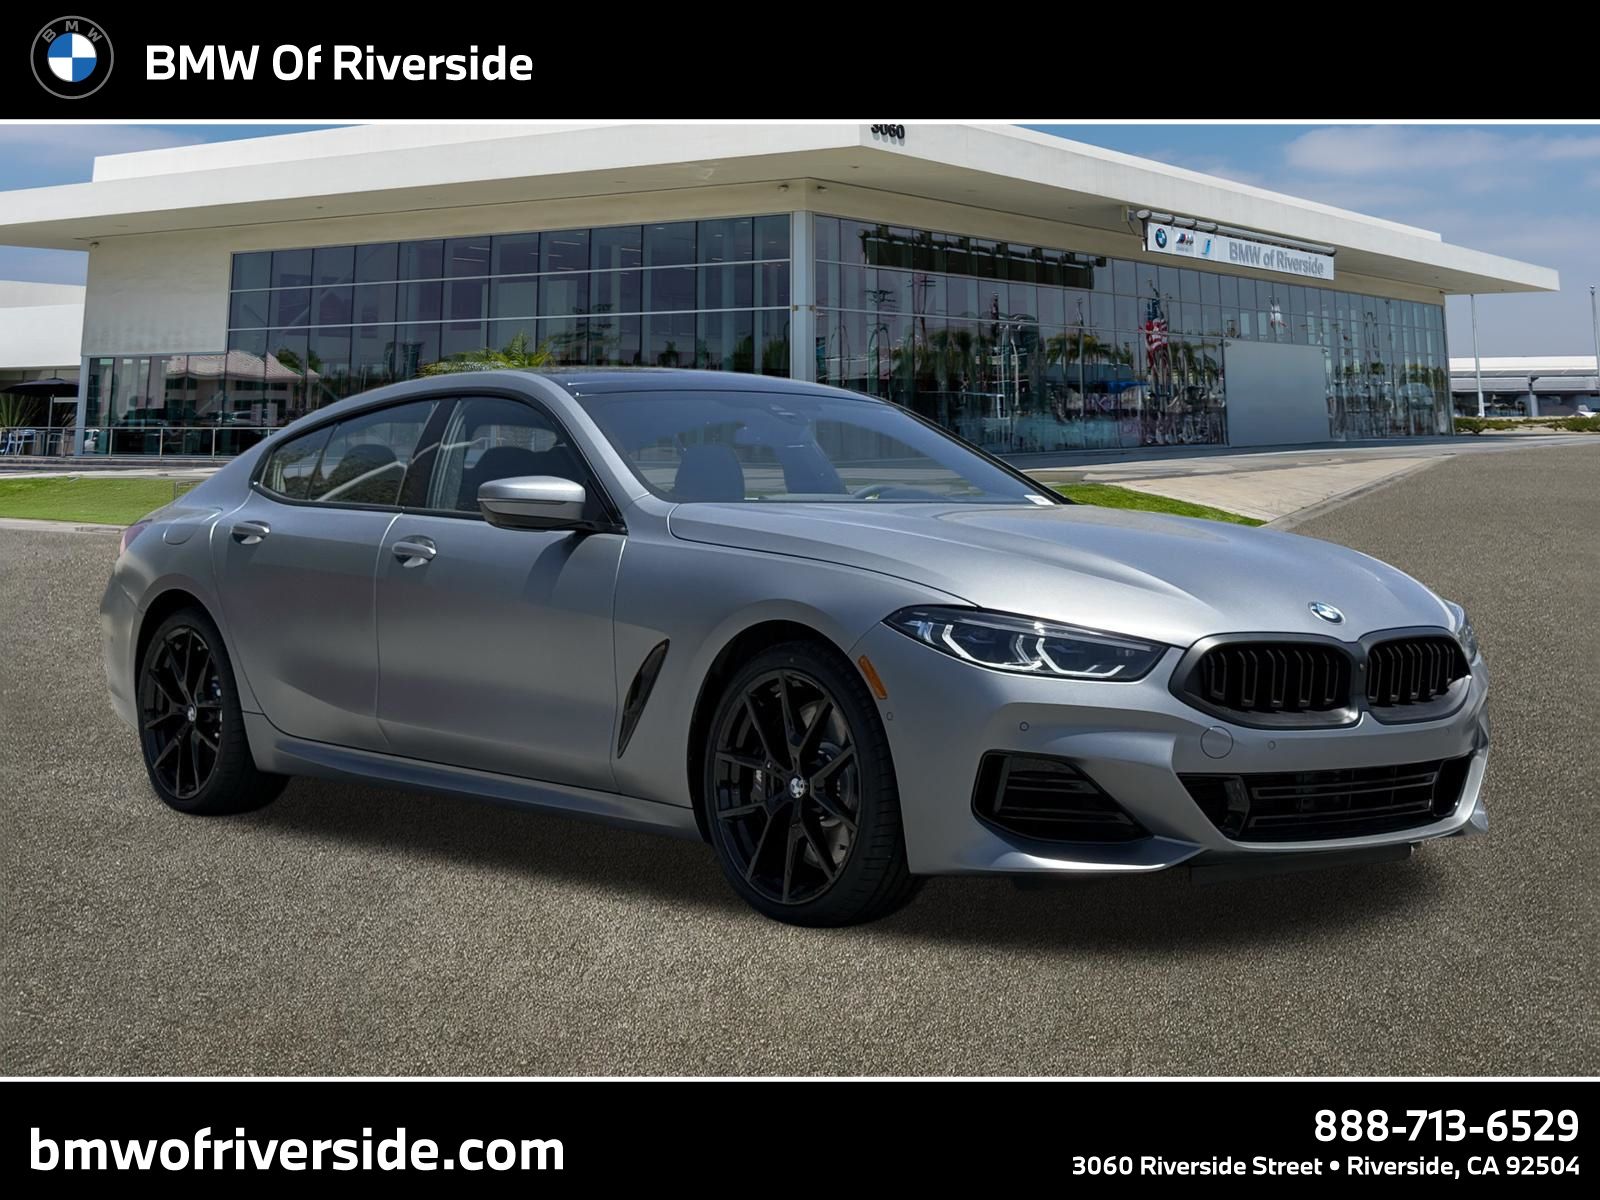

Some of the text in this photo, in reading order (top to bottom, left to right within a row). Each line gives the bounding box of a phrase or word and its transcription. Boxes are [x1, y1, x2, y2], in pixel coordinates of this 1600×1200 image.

[1229, 241, 1325, 275] BMW of Riverside
